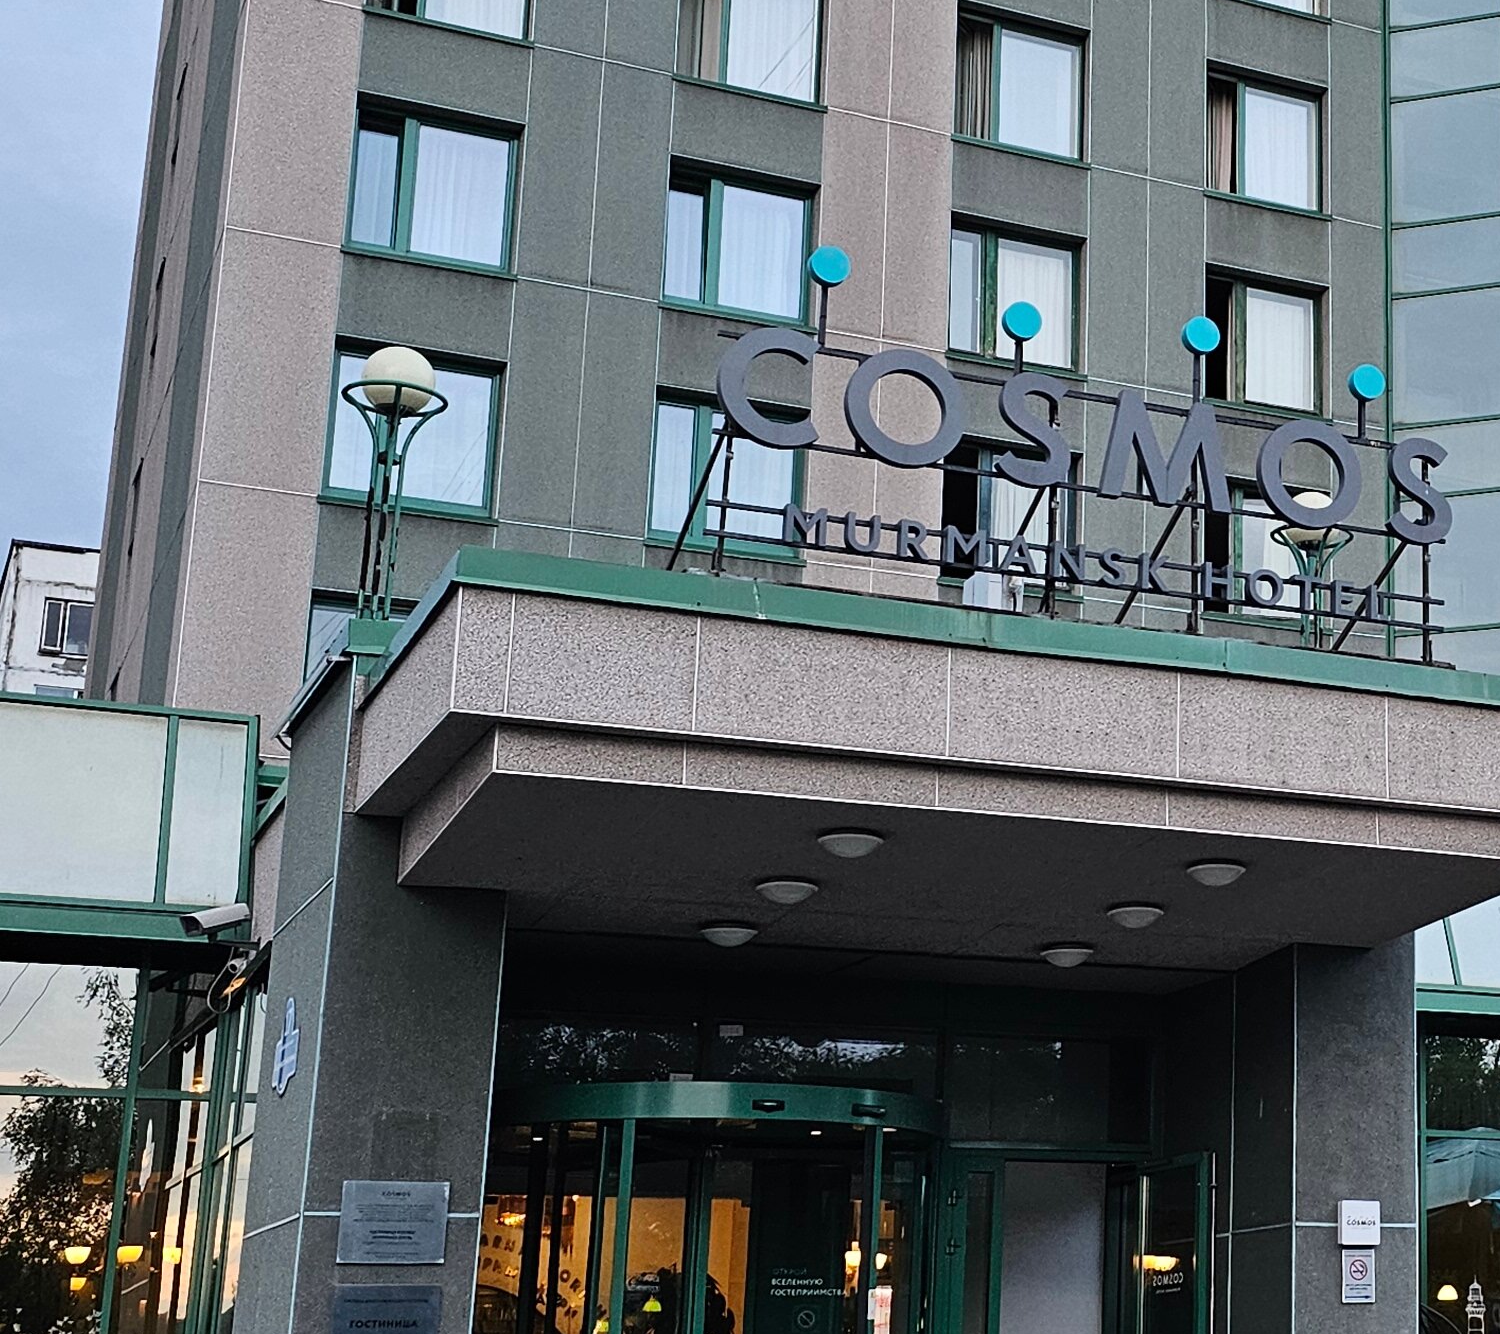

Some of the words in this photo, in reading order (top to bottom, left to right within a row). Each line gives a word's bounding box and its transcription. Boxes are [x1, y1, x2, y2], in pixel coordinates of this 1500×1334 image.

[716, 327, 1453, 545] COSMOS
[784, 502, 1169, 593] MURMANSK
[1200, 560, 1385, 620] HOTEL
[771, 1278, 823, 1286] ВСЕЛЕННУЮ
[348, 1319, 419, 1329] ГОСТИНИЦА
